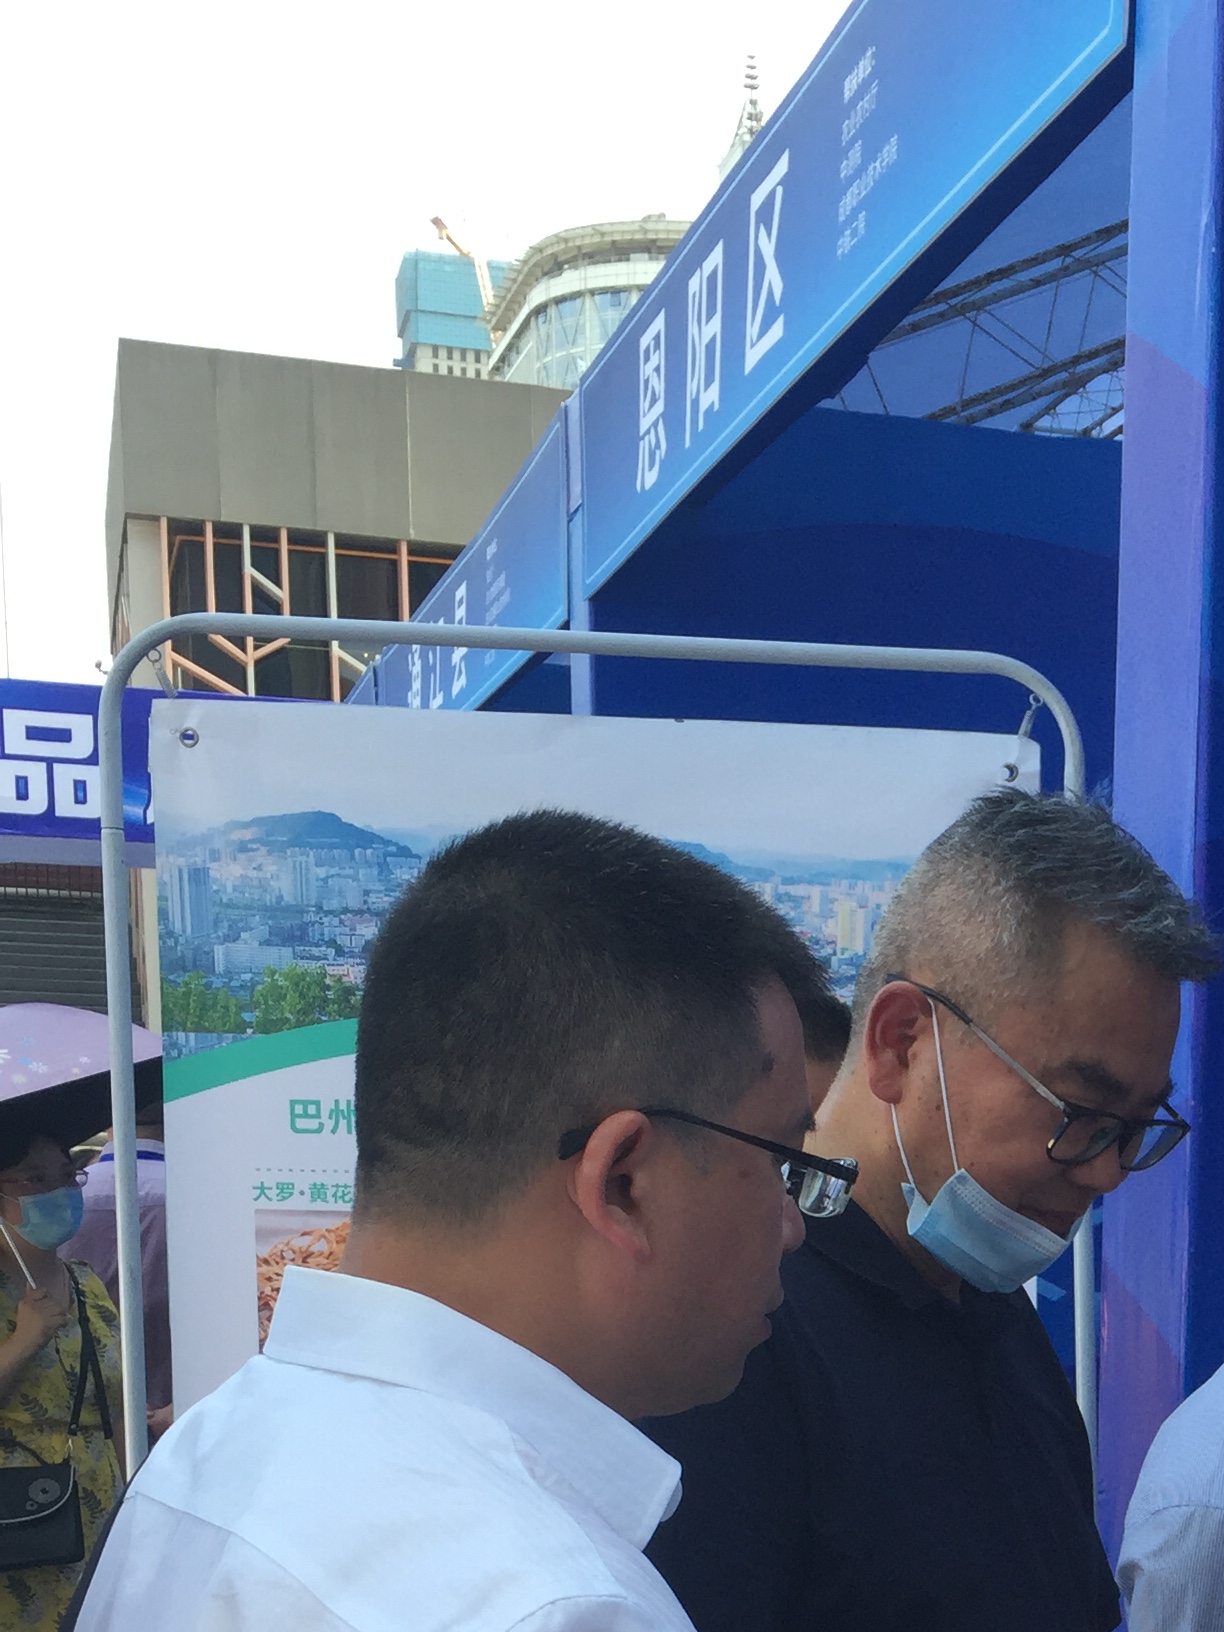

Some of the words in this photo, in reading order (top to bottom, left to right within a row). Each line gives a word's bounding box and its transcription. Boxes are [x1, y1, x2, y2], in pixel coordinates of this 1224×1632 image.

[636, 148, 790, 493] 恩阳区
[0, 708, 153, 826] 品
